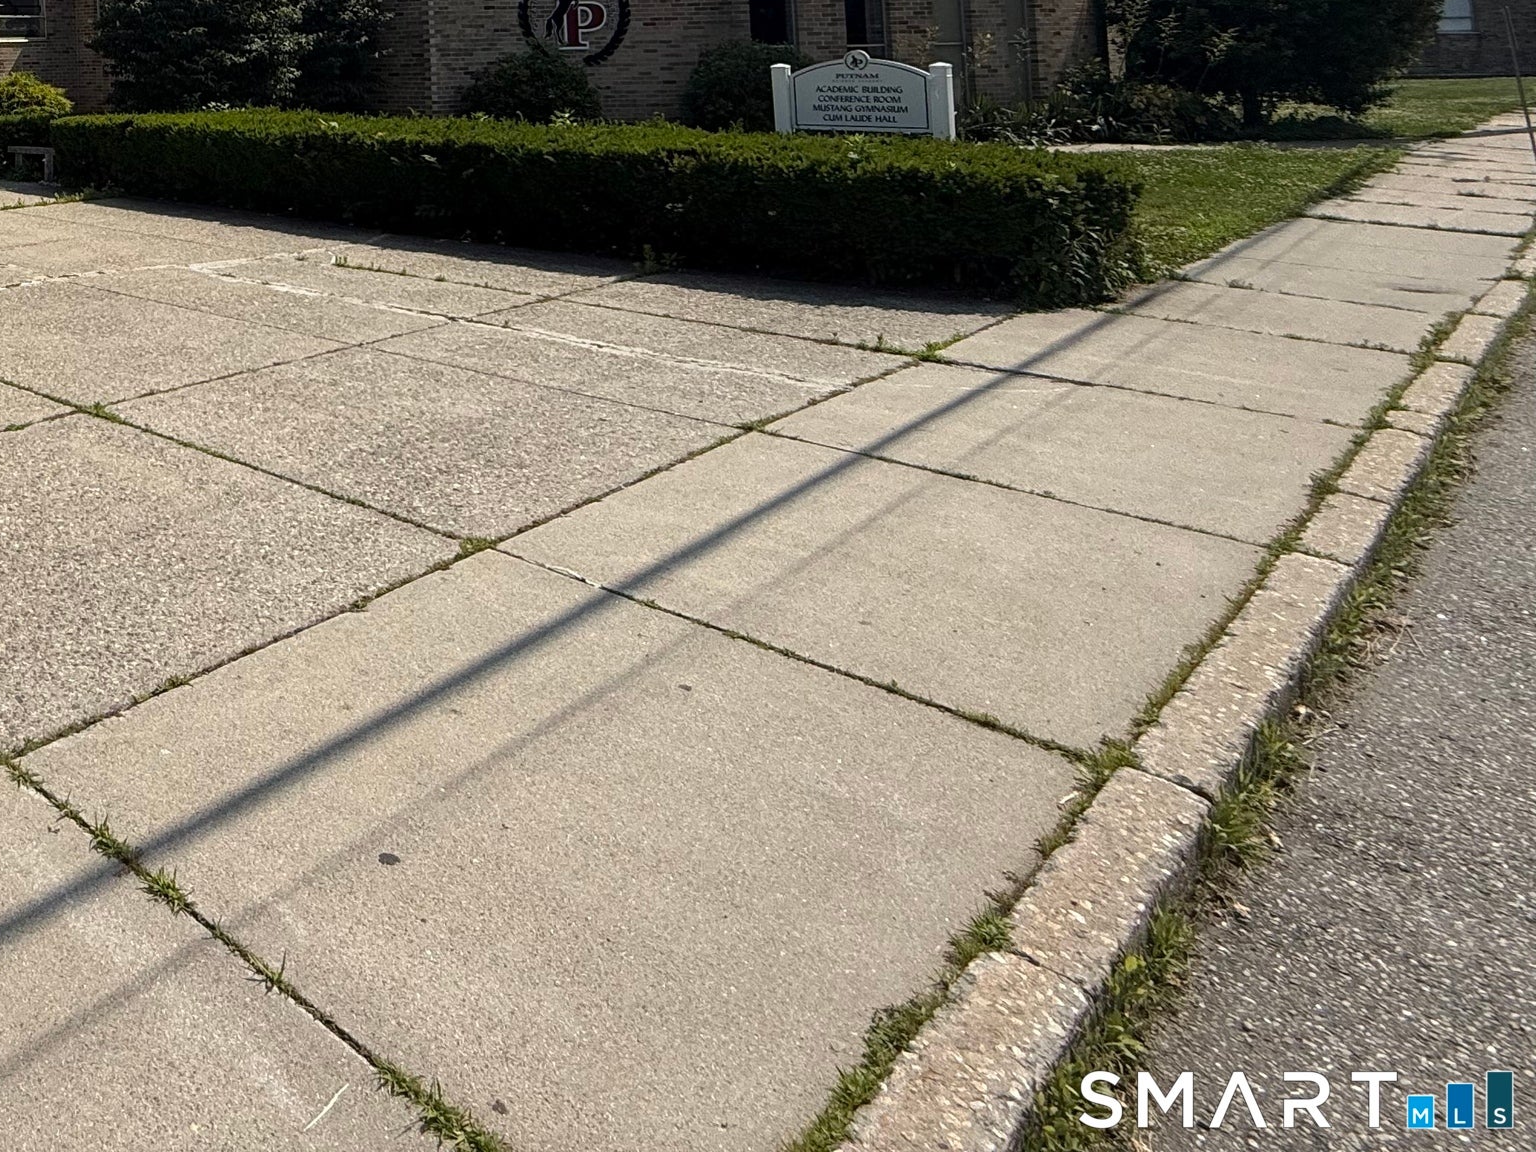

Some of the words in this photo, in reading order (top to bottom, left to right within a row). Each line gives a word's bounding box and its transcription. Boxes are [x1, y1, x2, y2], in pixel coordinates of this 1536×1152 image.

[560, 1, 606, 50] P
[816, 85, 859, 94] ACADEMIC
[862, 86, 903, 94] BUILDING
[817, 95, 871, 103] CONFERENCE
[873, 95, 902, 104] ROOM
[812, 104, 852, 112] MUSTANG
[854, 105, 909, 113] GYMNASIUM
[822, 114, 843, 122] CUM
[845, 114, 872, 122] LAUDE
[875, 115, 898, 123] HALL
